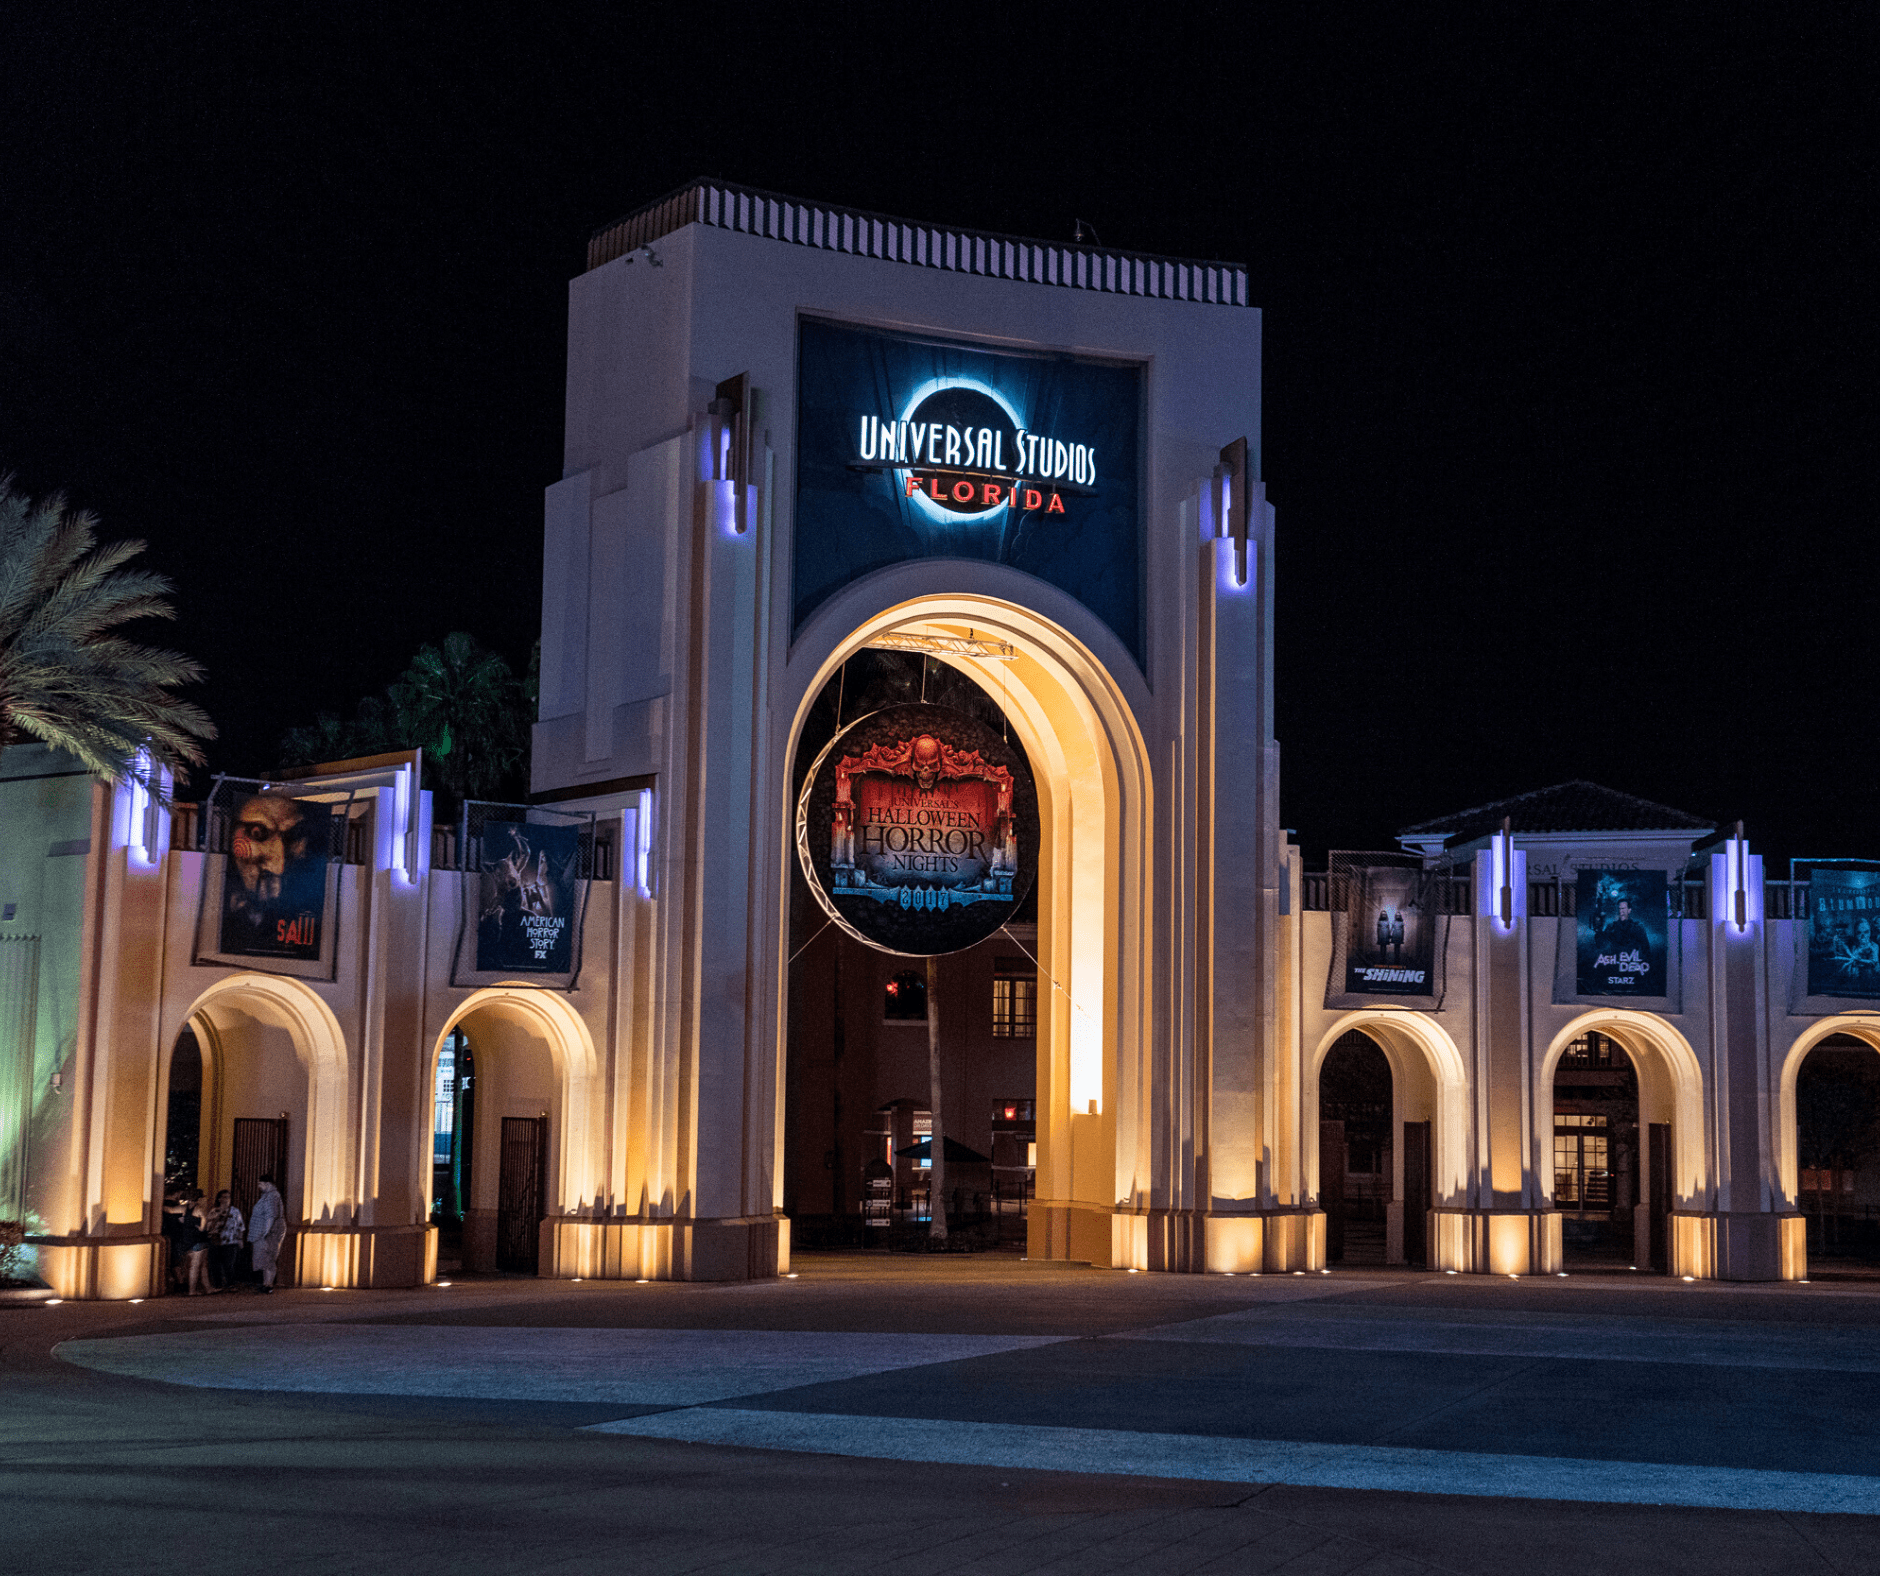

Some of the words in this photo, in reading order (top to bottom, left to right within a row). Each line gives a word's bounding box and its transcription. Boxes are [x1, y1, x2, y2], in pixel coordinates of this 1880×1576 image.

[860, 415, 1006, 471] UNIVERSAL
[1015, 429, 1096, 486] STUDIOS
[905, 476, 1066, 514] FLORIDA
[868, 807, 981, 828] HALLOWEEN
[860, 825, 991, 866] HORROR
[892, 854, 959, 873] NIGHTS
[903, 890, 947, 906] 2017
[520, 915, 565, 929] AMERICAN
[277, 916, 315, 946] SAW
[526, 927, 560, 939] HORROR
[529, 938, 556, 950] STORY
[534, 950, 547, 959] FX
[1619, 949, 1643, 962] EVIL
[1619, 961, 1650, 976] DEAD
[1607, 976, 1635, 985] STARZ
